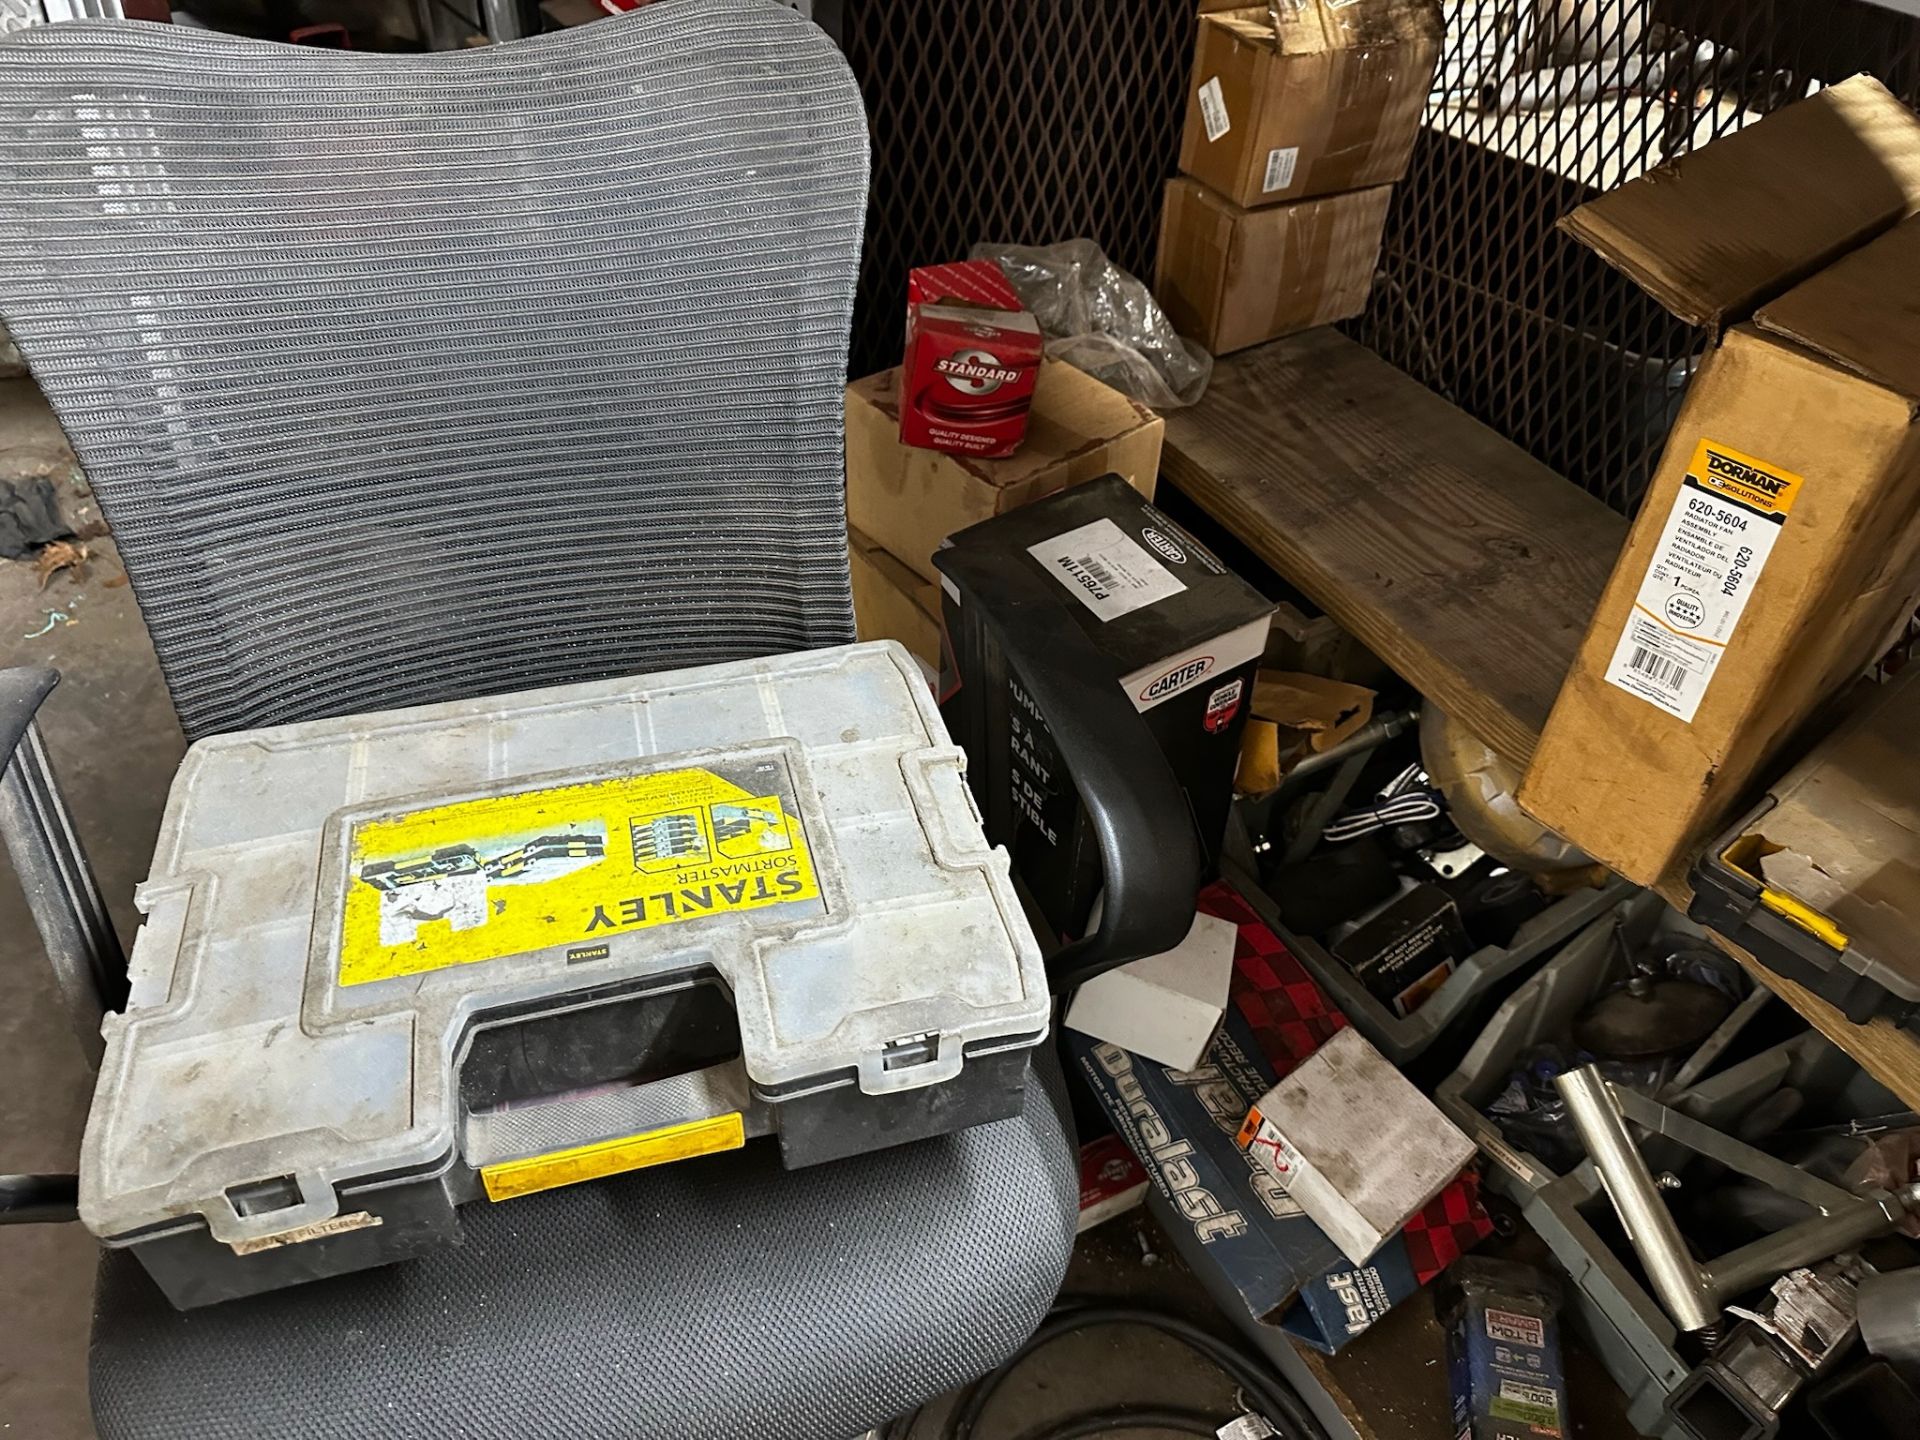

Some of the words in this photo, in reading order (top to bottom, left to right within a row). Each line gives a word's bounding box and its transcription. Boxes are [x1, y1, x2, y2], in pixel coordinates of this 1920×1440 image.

[938, 360, 1017, 381] STANDARD
[929, 428, 960, 439] QUALITY
[960, 434, 996, 444] DESIGNED
[933, 438, 963, 447] QUALITY
[964, 442, 985, 450] BUILT
[1708, 456, 1782, 494] DORMAN
[1681, 519, 1717, 537] ASSEMBLY
[1685, 511, 1718, 529] RADIATOR
[1719, 526, 1734, 535] FAN
[1688, 498, 1748, 531] 620-5604
[1147, 530, 1181, 561] CARTER
[1671, 543, 1706, 561] RADIADOR
[1675, 535, 1716, 557] VENTILADOR
[1716, 553, 1729, 563] DEL
[1678, 528, 1713, 547] ENSAMBLE
[1714, 543, 1724, 551] DE
[1057, 556, 1110, 600] P76511M
[1665, 559, 1702, 578] RADIATEUR
[1668, 552, 1712, 574] VENTILATEUR
[1713, 571, 1723, 579] DU
[1721, 546, 1753, 597] 620-5604
[1673, 576, 1681, 587] 1
[1668, 609, 1696, 625] INNOVATION
[1676, 598, 1699, 612] QUALITY
[1149, 661, 1206, 696] CARTER
[1023, 780, 1043, 810] DE
[1012, 786, 1057, 846] STIBLE
[677, 855, 797, 884] SORTMASTER
[584, 870, 803, 932] STANLEY
[568, 947, 608, 960] STANLEY
[1080, 1056, 1105, 1091] MOTOR
[1103, 1091, 1115, 1106] DE
[1090, 1042, 1248, 1244] Duralast
[1114, 1098, 1170, 1198] REMANUFACTURED
[299, 1218, 360, 1238] FILTERS
[1326, 1272, 1371, 1334] last
[1353, 1269, 1374, 1309] STARTER
[1491, 1326, 1523, 1339] TOW
